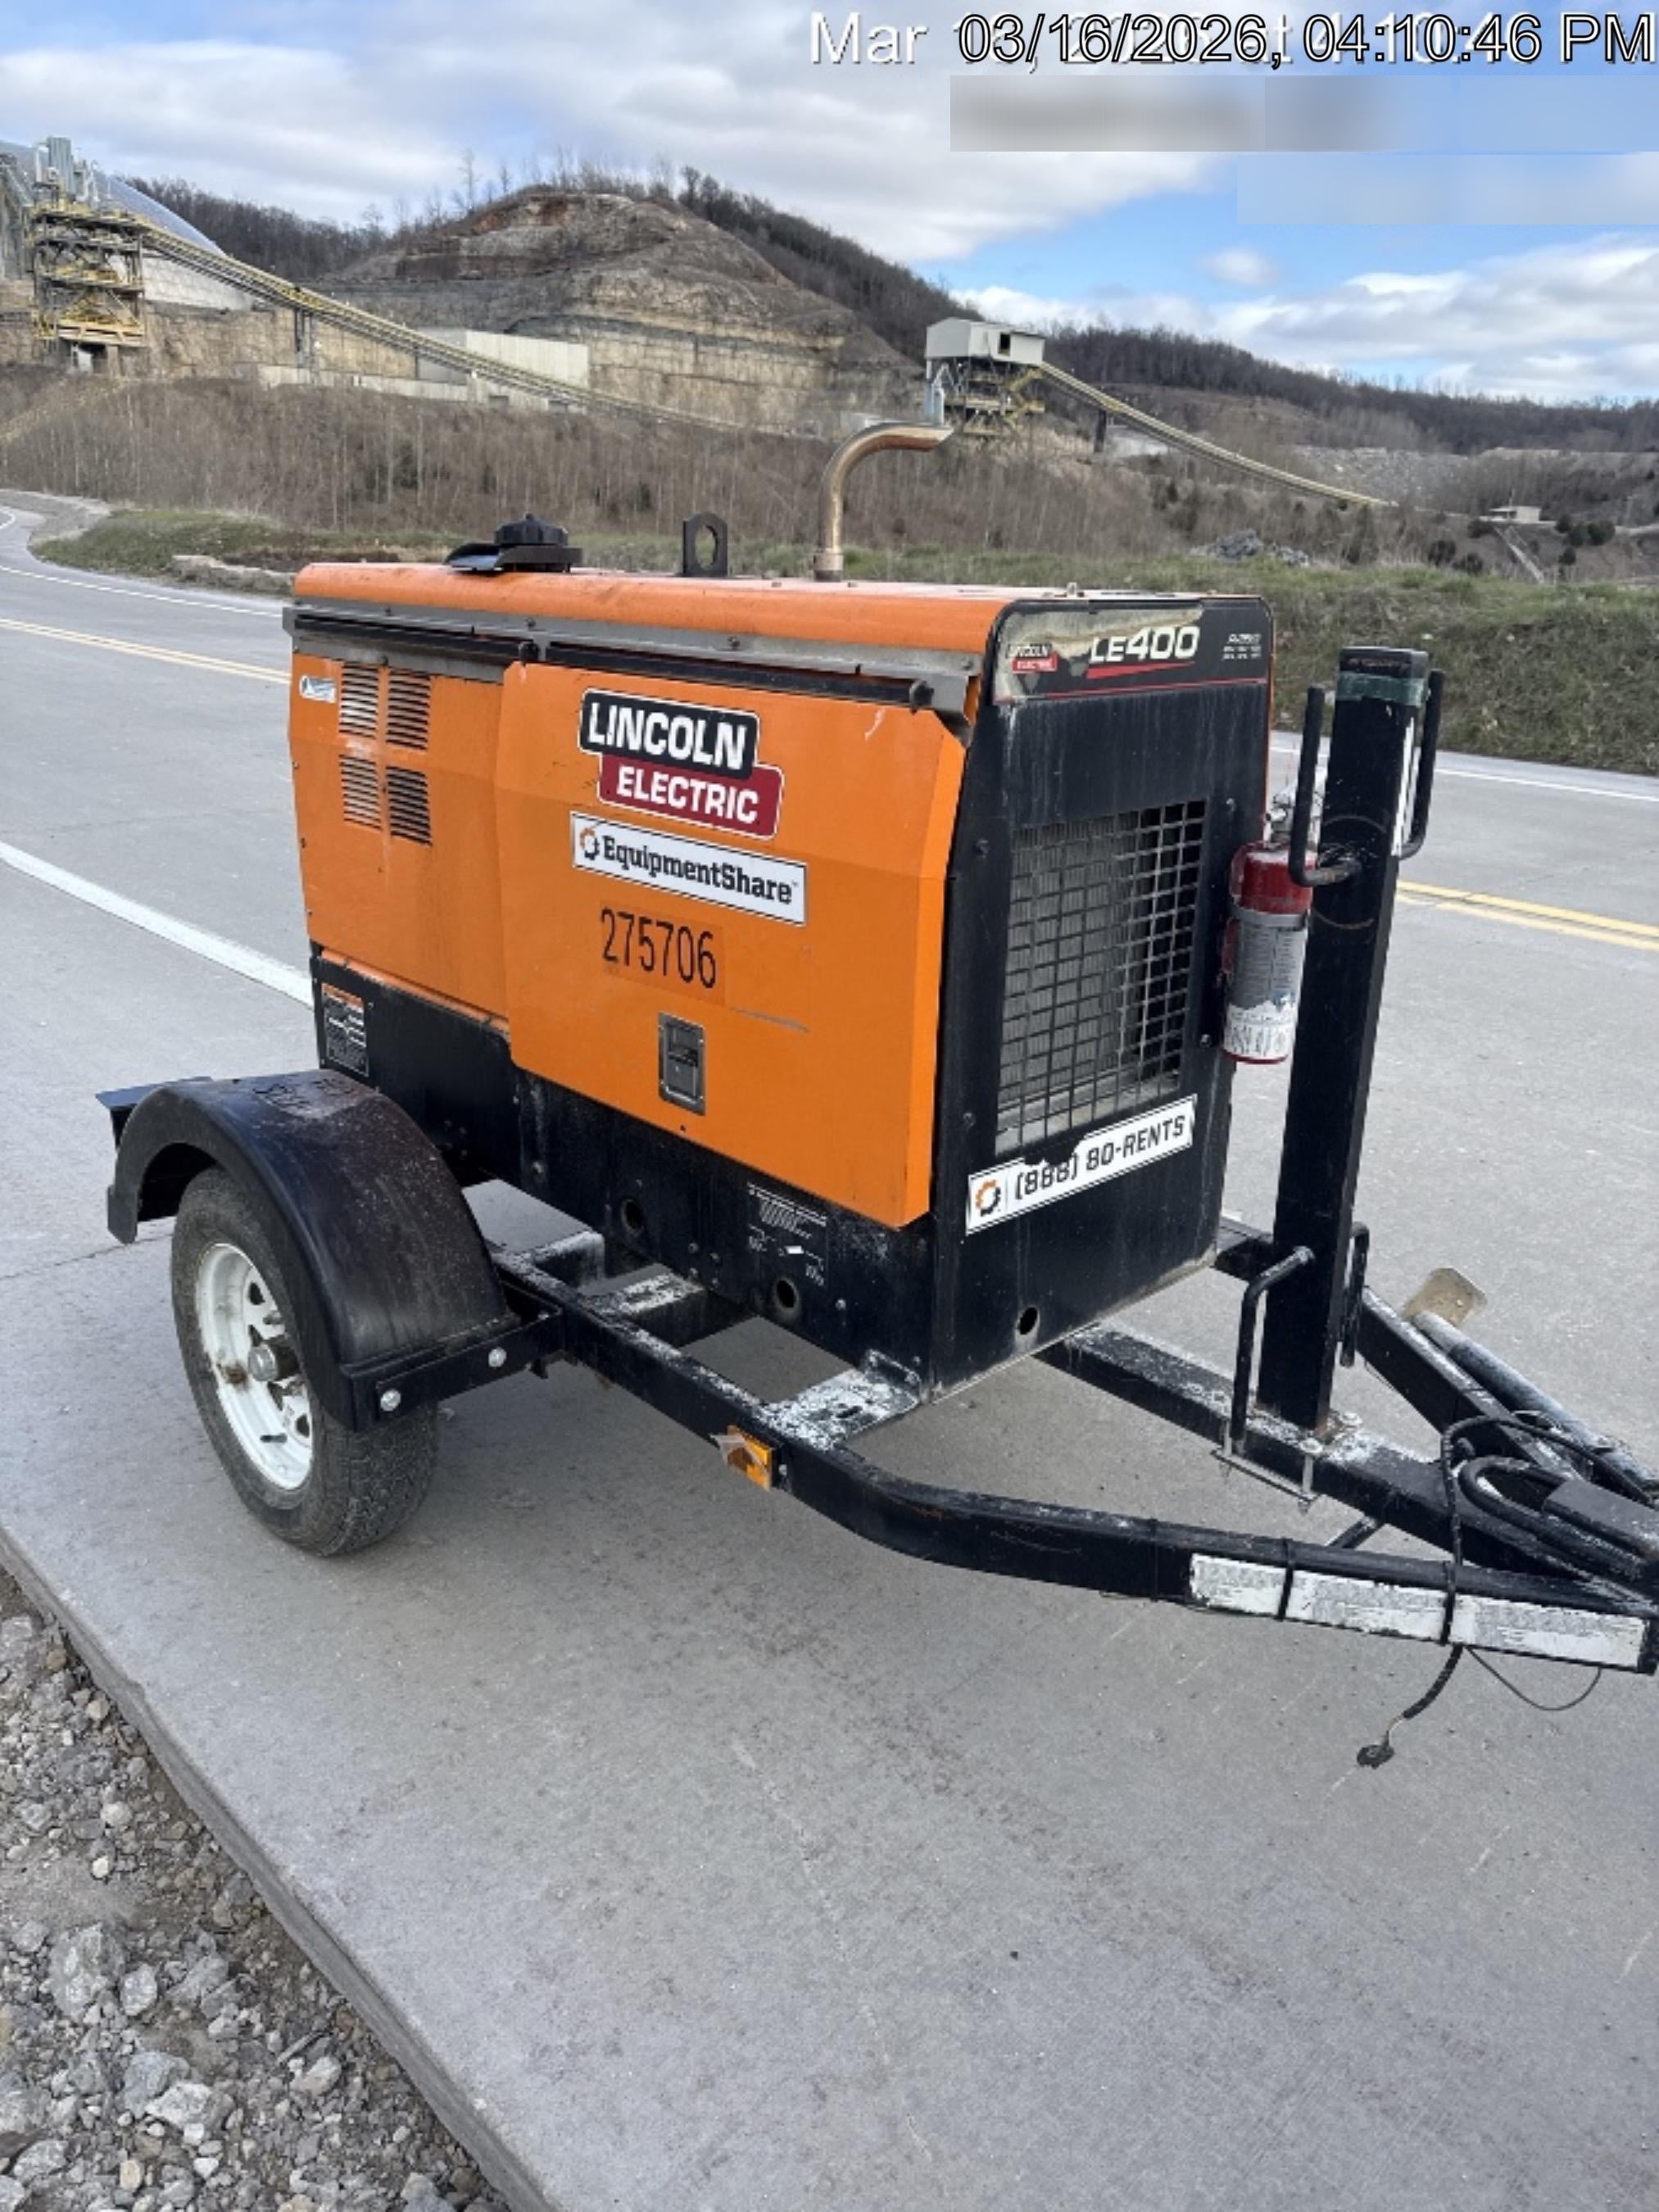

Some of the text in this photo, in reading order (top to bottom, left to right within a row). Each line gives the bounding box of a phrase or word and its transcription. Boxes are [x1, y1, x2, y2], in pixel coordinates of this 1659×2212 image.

[1090, 627, 1199, 664] LE400
[587, 702, 747, 770] LINCOLN
[617, 765, 759, 823] ELECTRIC
[602, 836, 792, 904] EquipmentShare
[601, 908, 716, 989] 275706
